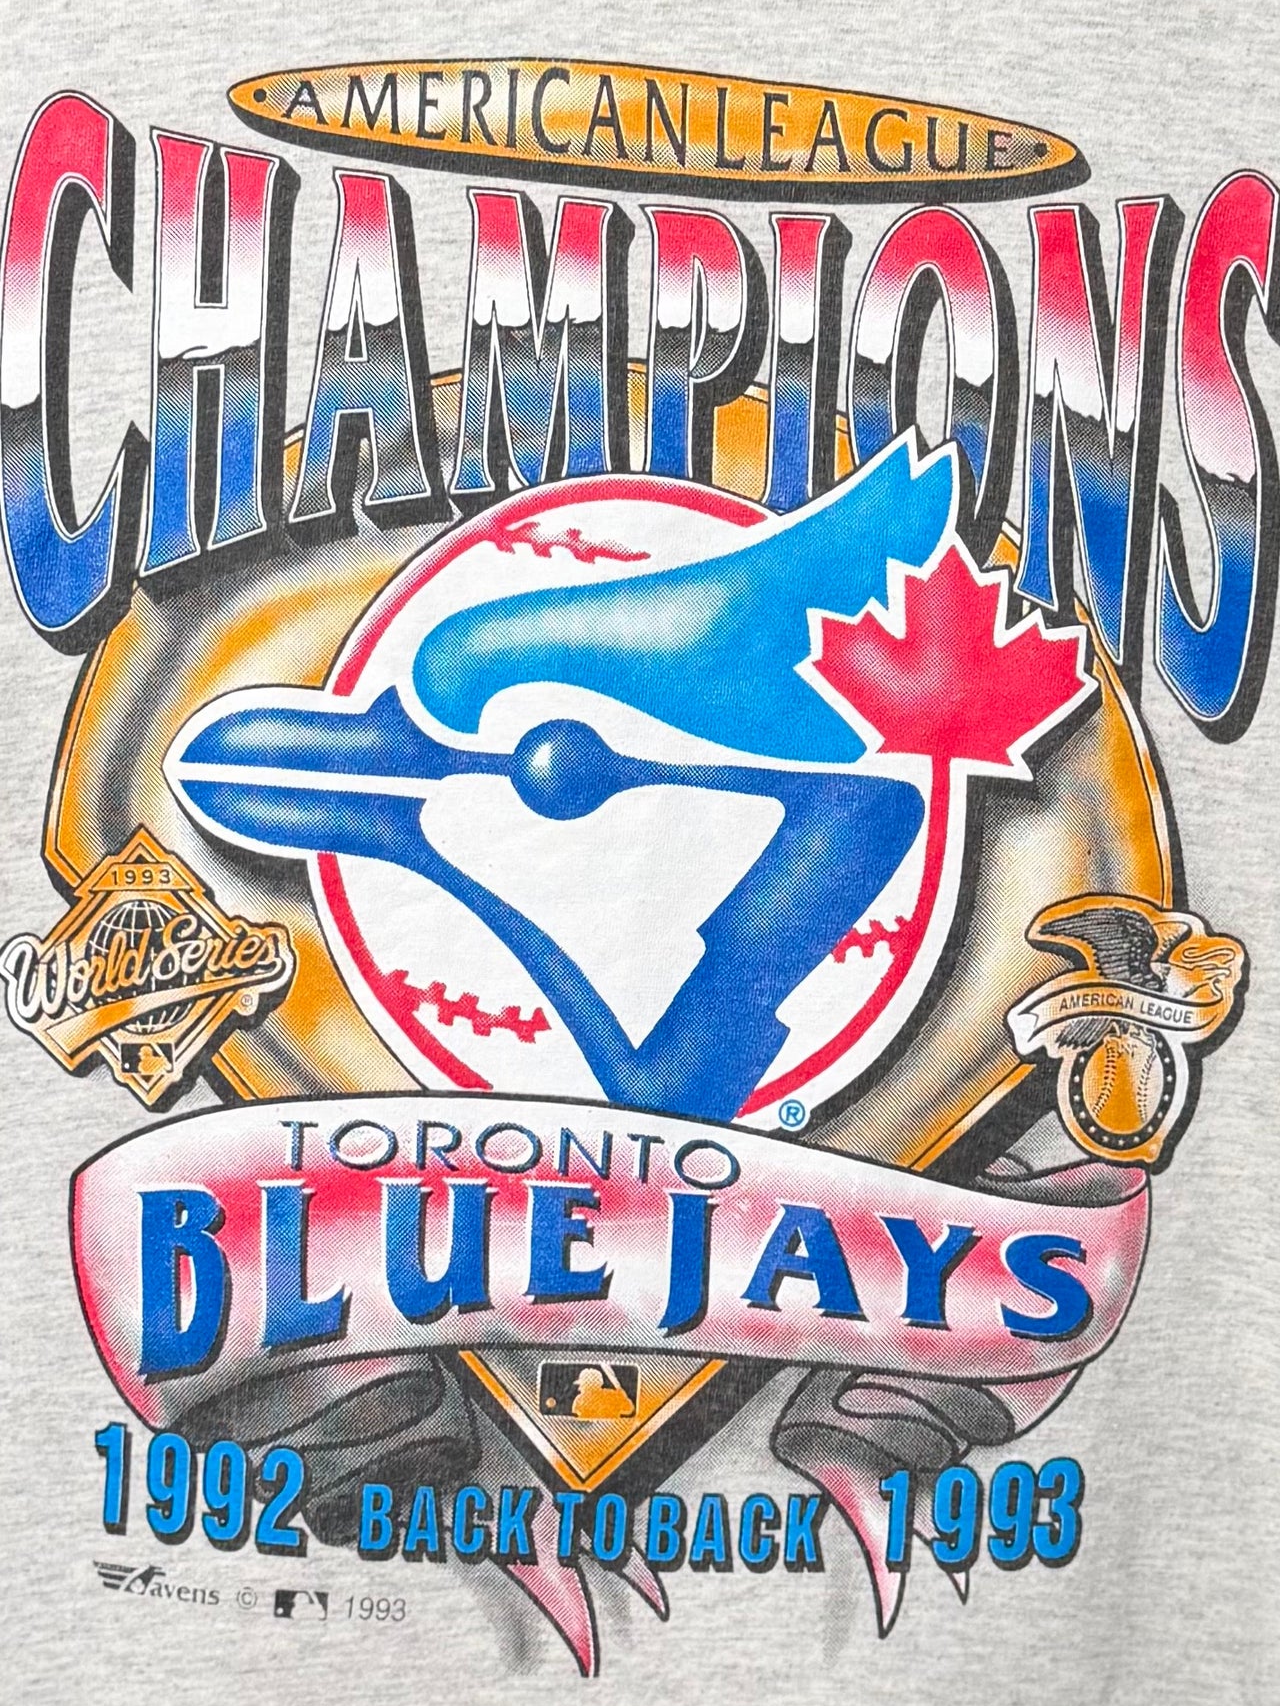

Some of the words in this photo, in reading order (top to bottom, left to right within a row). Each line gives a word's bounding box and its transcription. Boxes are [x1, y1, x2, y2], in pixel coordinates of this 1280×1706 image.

[281, 68, 690, 168] AMERICAN
[716, 87, 1017, 174] LEAGUE
[111, 869, 173, 885] 1993
[0, 927, 152, 1020] World
[151, 914, 283, 980] Series
[1059, 992, 1134, 1013] AMERICAN
[1140, 998, 1194, 1024] LEAGUE
[278, 1118, 743, 1192] TORONTO
[135, 1180, 612, 1383] BLUE
[661, 1191, 1096, 1341] JAYS
[94, 1421, 310, 1558] 1992
[358, 1482, 539, 1566] BACK
[556, 1491, 632, 1574] TO
[646, 1493, 826, 1574] BACK
[880, 1456, 1085, 1574] 1993
[343, 1596, 407, 1622] 1993
